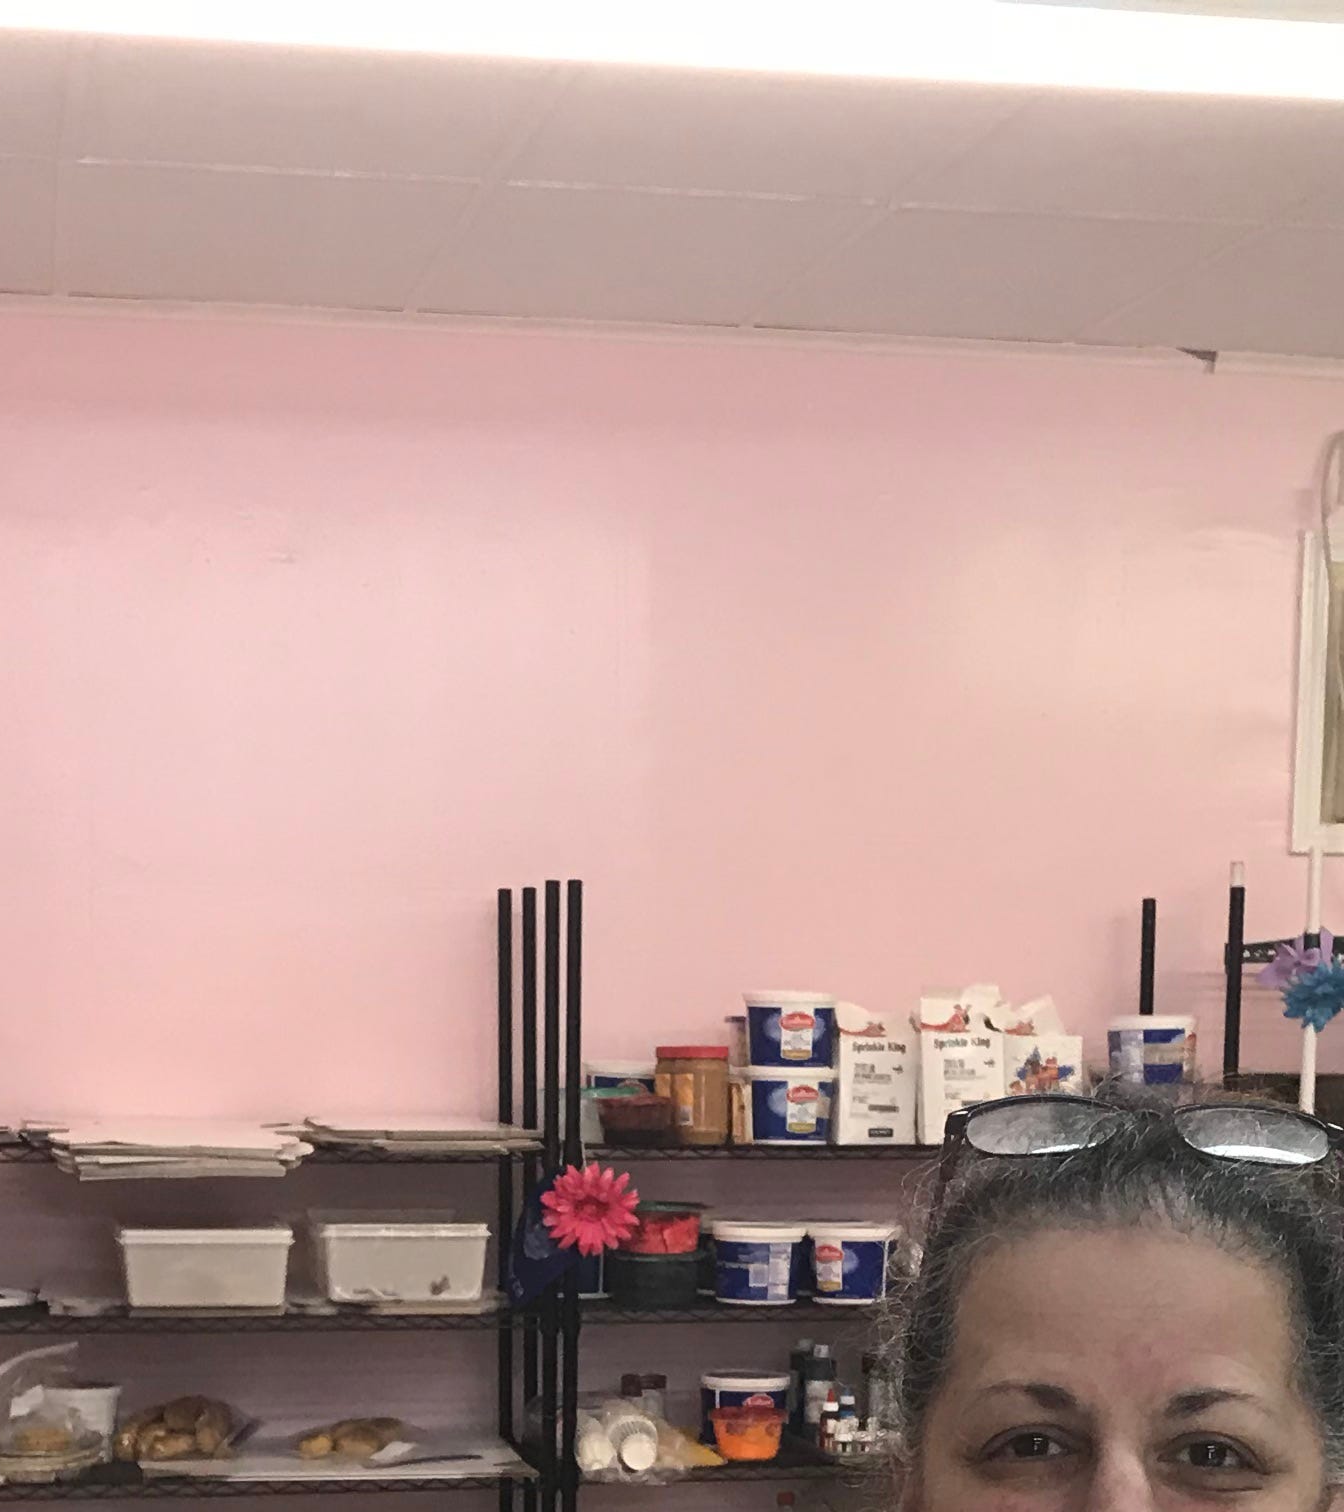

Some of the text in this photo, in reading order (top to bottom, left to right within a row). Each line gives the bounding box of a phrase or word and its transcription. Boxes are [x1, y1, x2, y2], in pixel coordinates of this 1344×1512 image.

[852, 1041, 907, 1055] Sprinkle King
[934, 1036, 991, 1052] Sprinkle King
